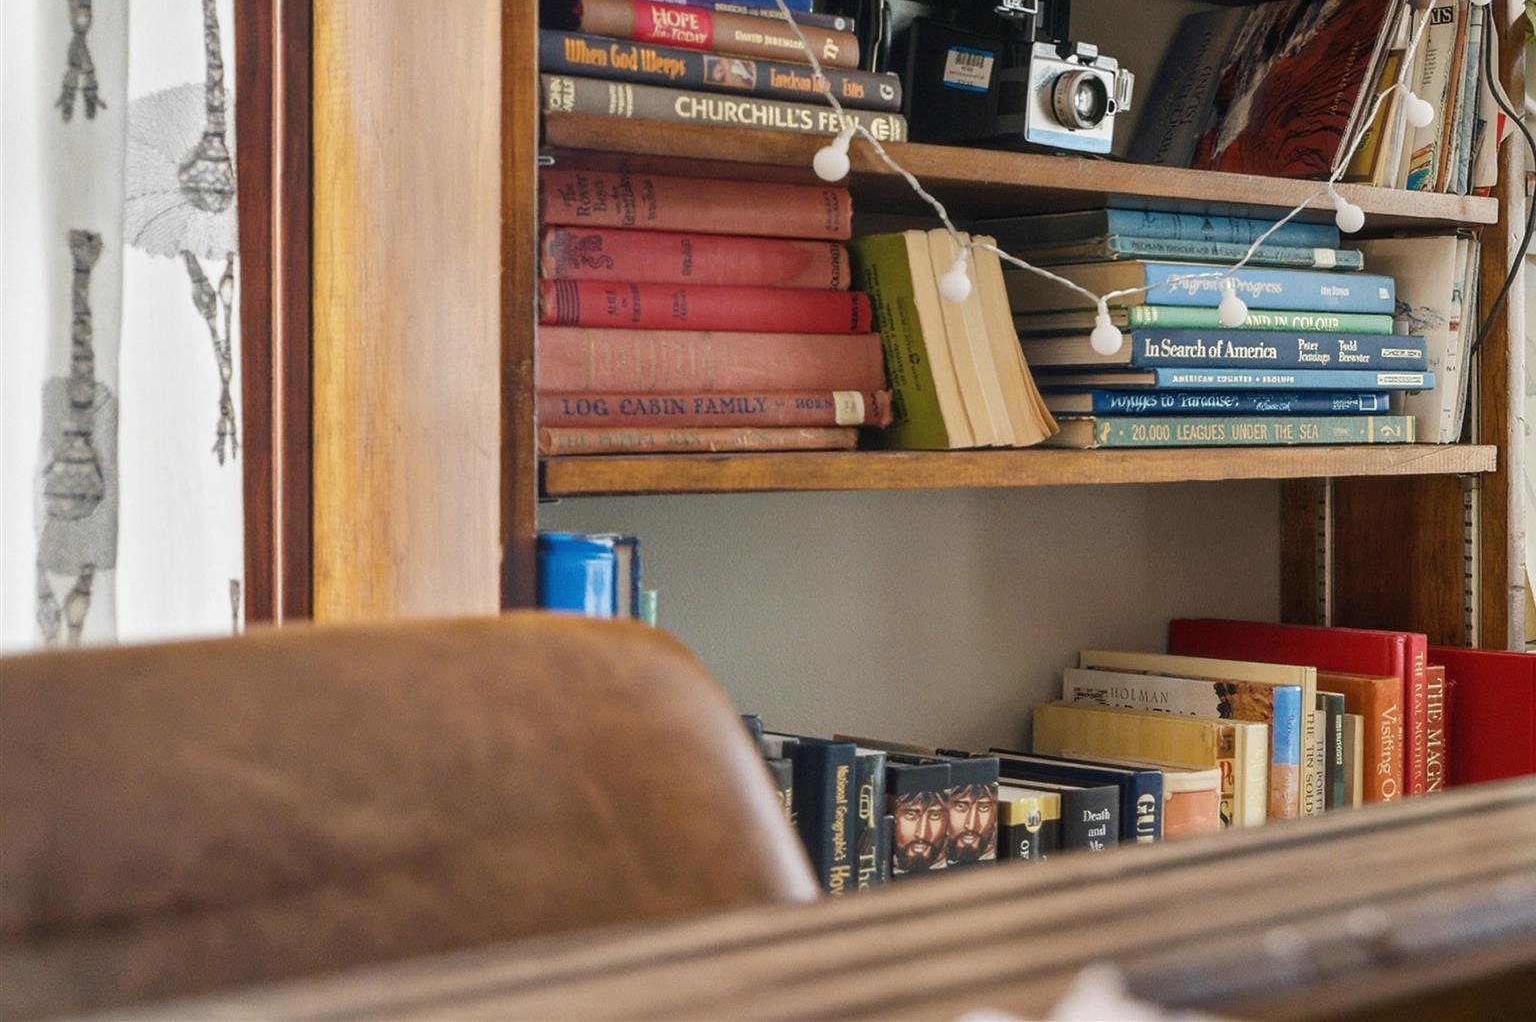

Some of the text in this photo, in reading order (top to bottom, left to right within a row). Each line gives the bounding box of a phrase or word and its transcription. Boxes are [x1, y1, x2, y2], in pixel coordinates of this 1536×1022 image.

[652, 5, 699, 29] HOPE
[671, 28, 708, 44] TODAY
[735, 30, 762, 44] DAVID
[564, 37, 687, 80] When God Weeps
[674, 96, 813, 130] CHURCHILL'S
[1274, 315, 1288, 327] IN
[1292, 316, 1339, 330] COLOUR
[1144, 337, 1278, 361] In Search of America
[1298, 338, 1319, 352] Peter
[1338, 339, 1358, 352] Todd
[1298, 351, 1331, 366] Jennings
[1172, 374, 1214, 384] AMERICAN
[561, 398, 609, 417] LOG
[619, 397, 685, 416] CABIN
[694, 396, 768, 415] FAMILY
[1131, 424, 1171, 441] 20,000
[1176, 424, 1225, 441] LEAGUES
[1231, 424, 1268, 441] UNDER
[1274, 424, 1293, 440] THE
[1300, 424, 1319, 440] SEA
[1415, 652, 1425, 677] THE
[1110, 686, 1169, 704] HOLMAN
[1427, 677, 1443, 723] THE
[1306, 712, 1315, 741] THE
[1378, 703, 1397, 775] Visiting
[836, 765, 849, 804] National
[1305, 773, 1314, 816] SOLD
[1083, 808, 1111, 823] Death
[1088, 824, 1106, 837] and
